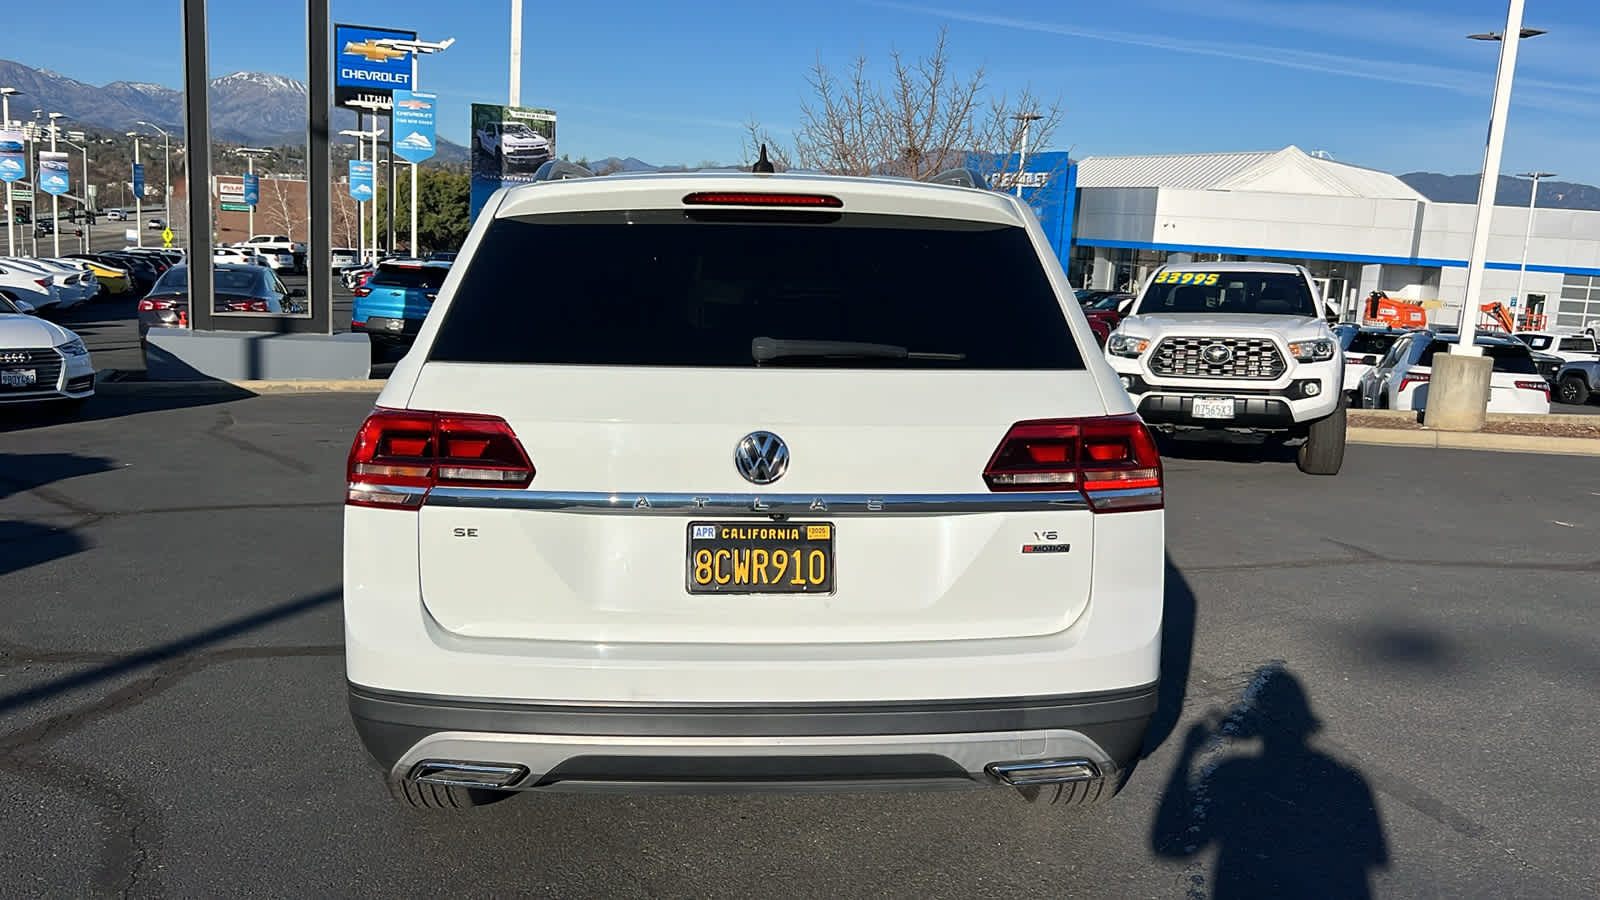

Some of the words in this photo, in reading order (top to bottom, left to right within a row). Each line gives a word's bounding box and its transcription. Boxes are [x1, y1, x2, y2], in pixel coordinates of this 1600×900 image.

[341, 68, 410, 83] CHEVROLET
[358, 94, 393, 105] LITHIA
[1154, 271, 1220, 286] 33995
[633, 495, 885, 511] ATLAS
[453, 527, 479, 538] SE
[695, 527, 715, 538] APR
[721, 528, 800, 540] CALIFORNIA
[1033, 530, 1059, 541] V6
[1022, 543, 1070, 553] MOTION
[695, 549, 826, 586] 8CWR910
